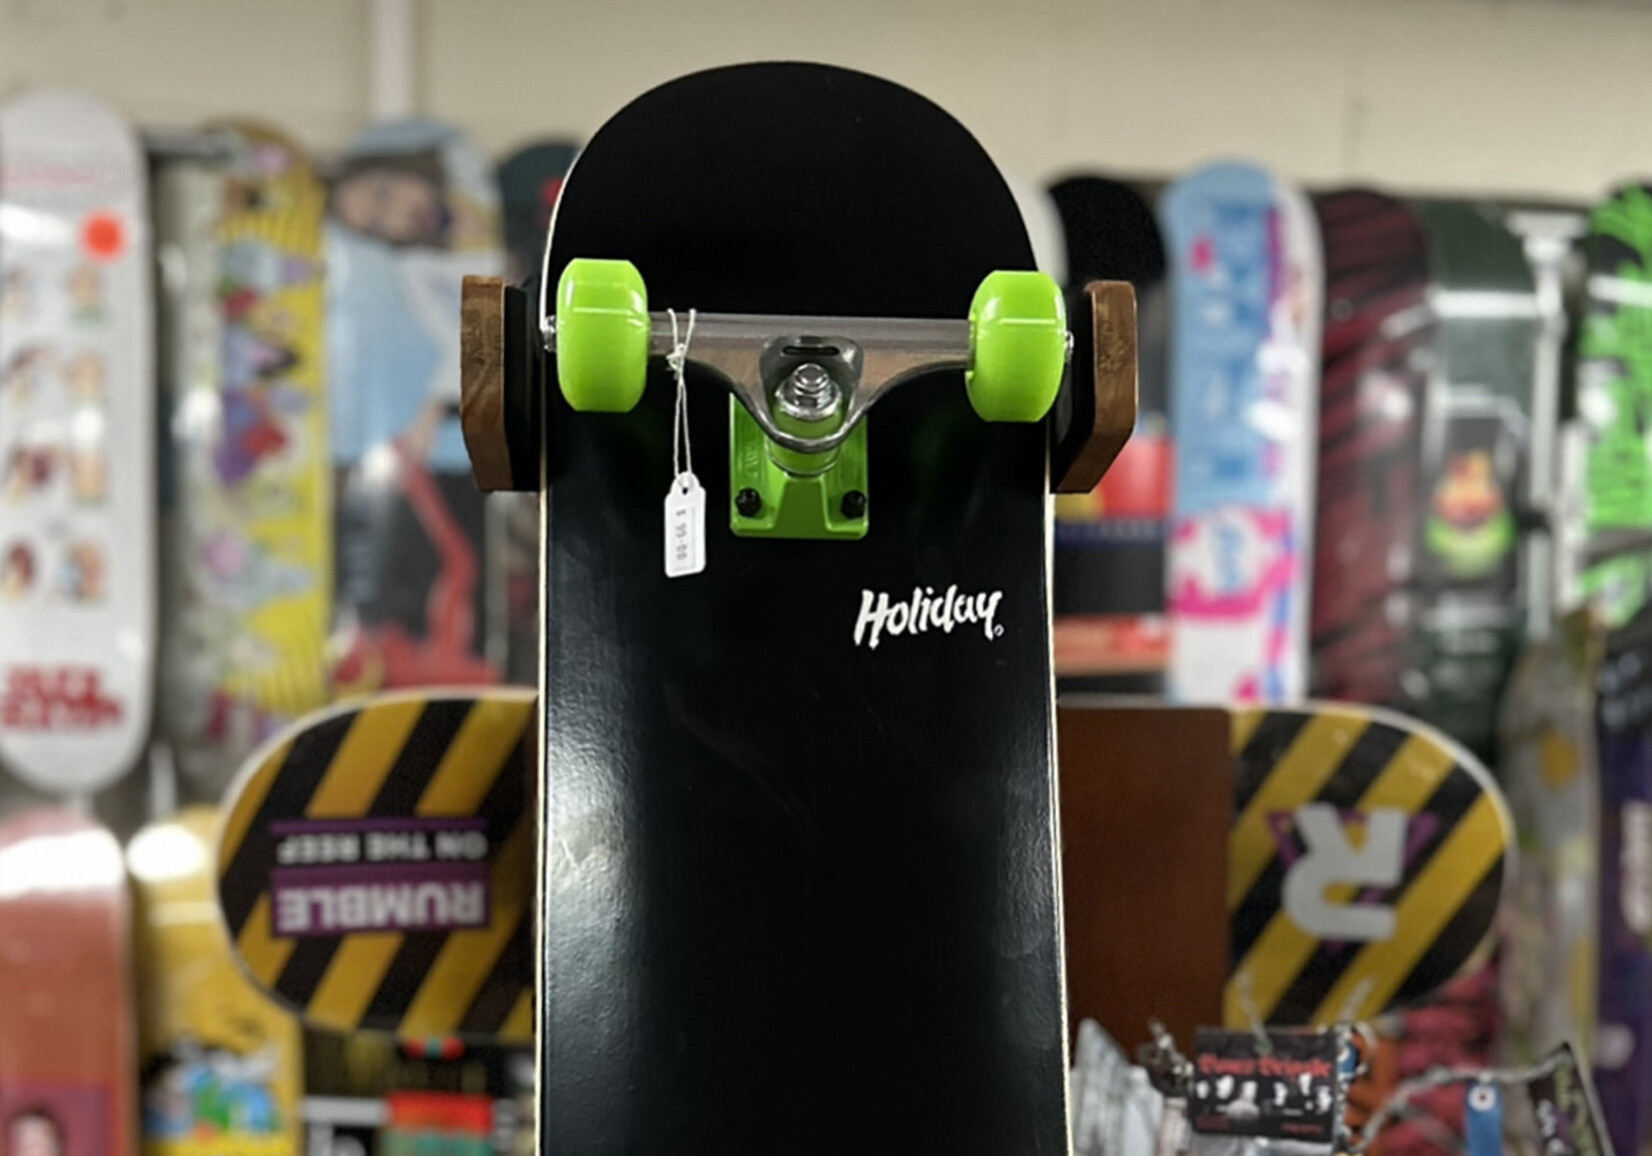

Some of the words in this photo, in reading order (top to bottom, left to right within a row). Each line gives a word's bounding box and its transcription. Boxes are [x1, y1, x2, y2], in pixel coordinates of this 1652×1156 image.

[854, 584, 1003, 650] Holiday
[364, 831, 432, 861] THE
[434, 830, 489, 860] ON
[1283, 802, 1408, 940] R
[277, 881, 485, 933] RUMBLE
